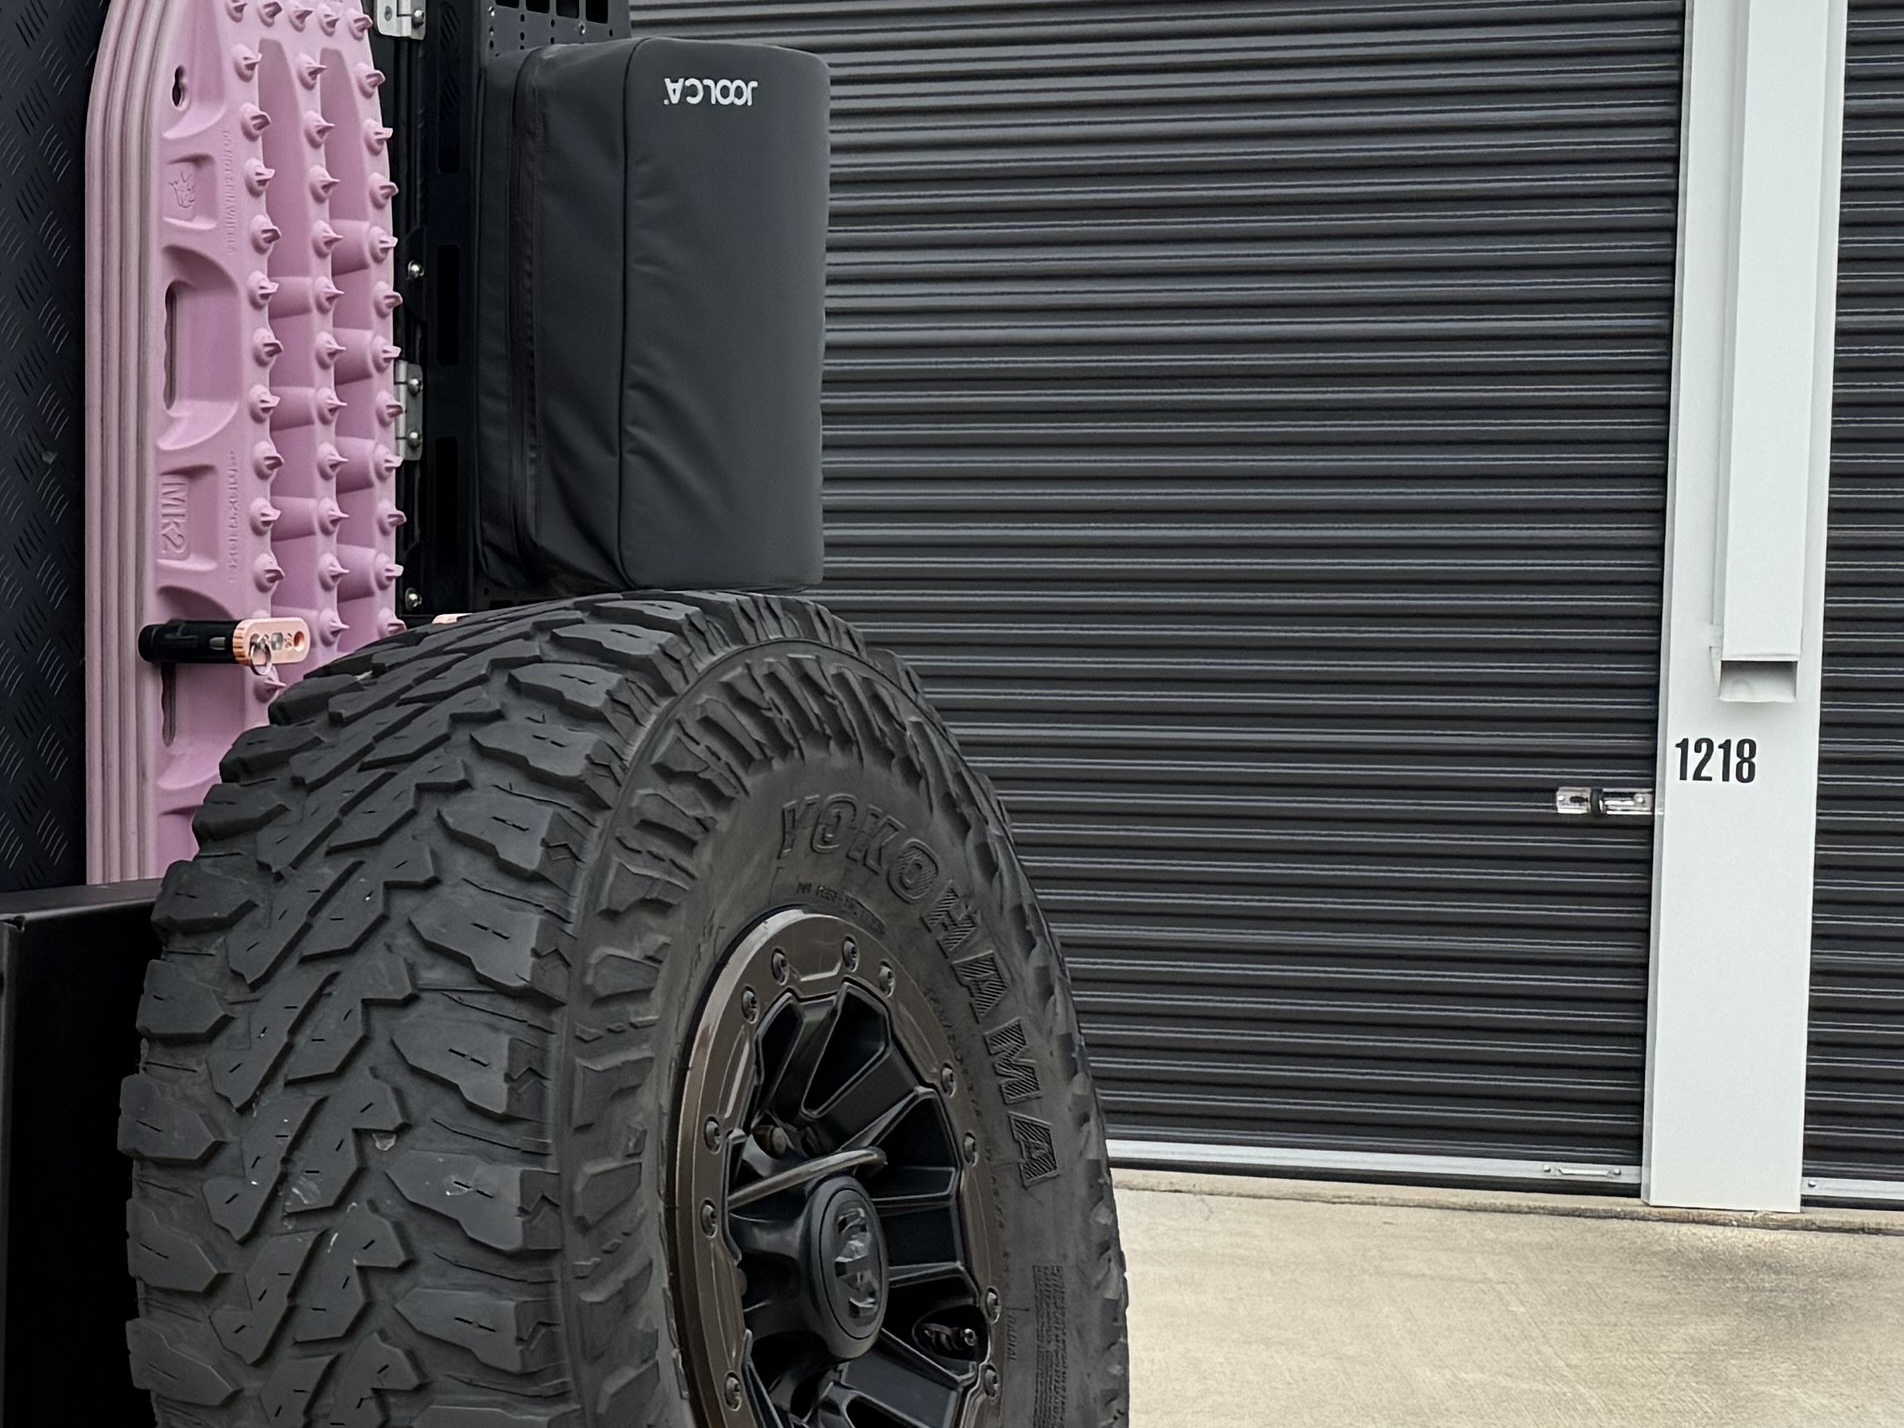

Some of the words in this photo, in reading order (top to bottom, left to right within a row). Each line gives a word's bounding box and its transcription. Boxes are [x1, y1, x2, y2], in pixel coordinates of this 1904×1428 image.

[664, 77, 759, 107] JOOLCA
[1674, 737, 1757, 783] 1218
[779, 793, 1060, 1189] YOKOHAMA
